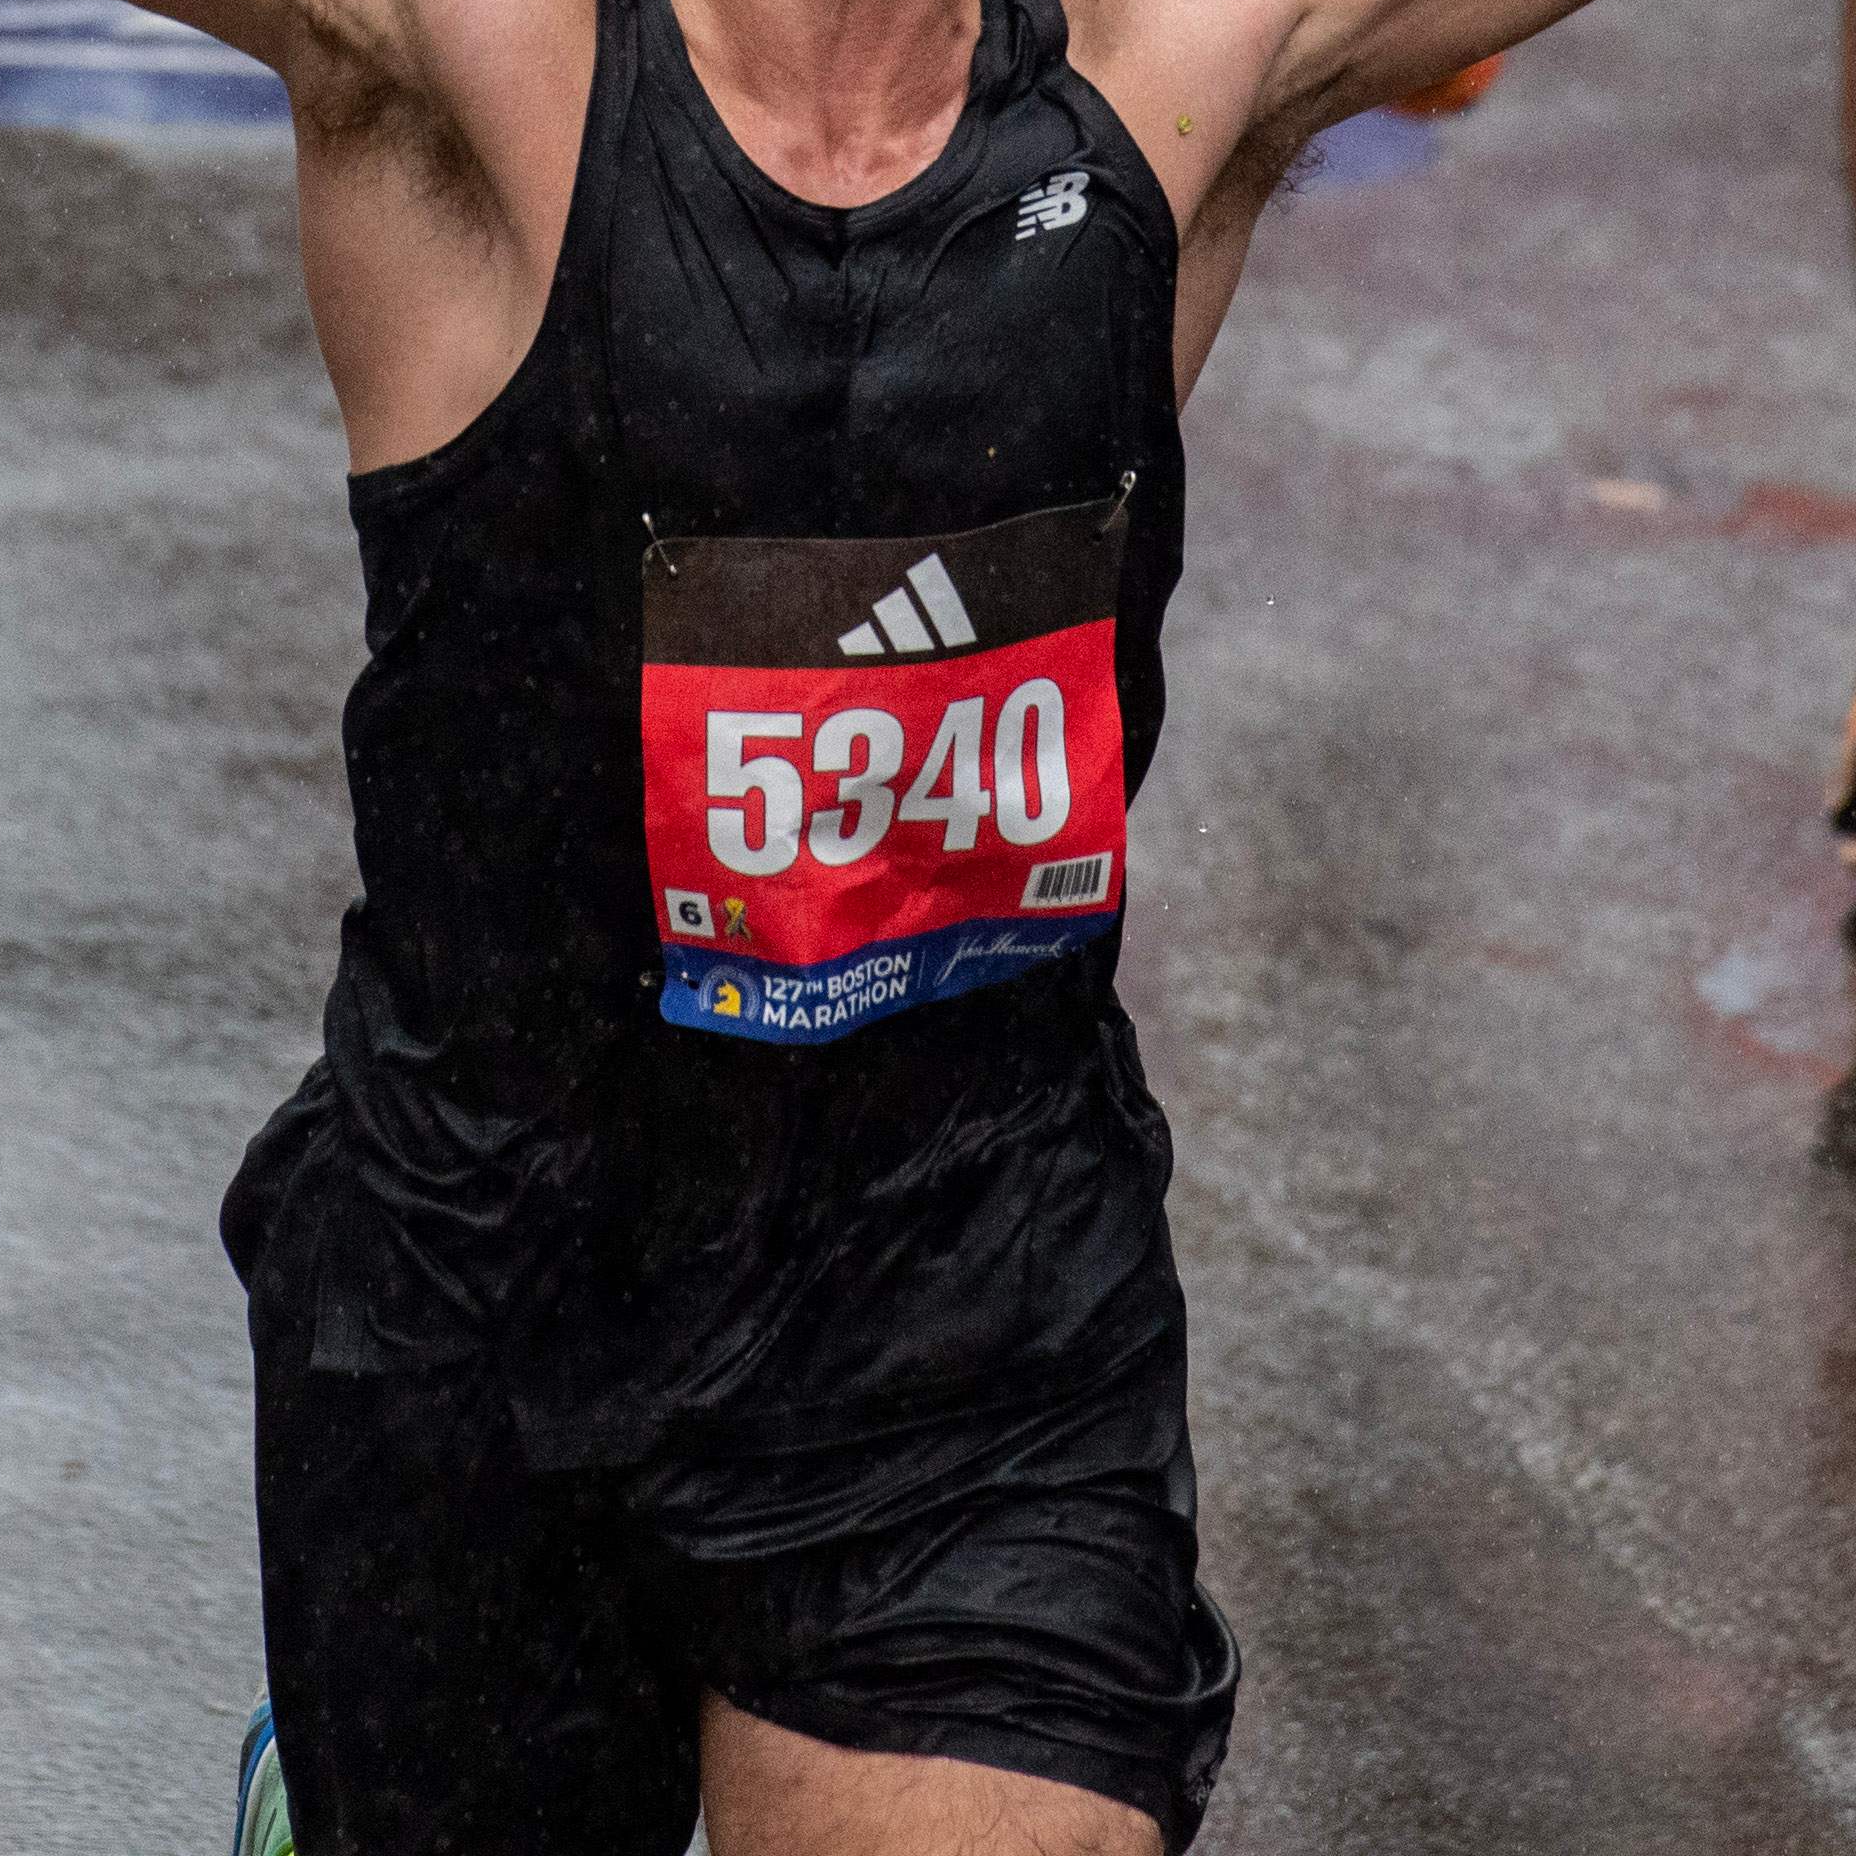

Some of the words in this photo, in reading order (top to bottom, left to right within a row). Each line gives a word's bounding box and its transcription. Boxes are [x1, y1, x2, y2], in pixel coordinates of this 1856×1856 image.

[706, 678, 1071, 877] 5340
[679, 901, 703, 927] 6
[827, 951, 912, 1000] BOSTON
[762, 976, 908, 1029] MARATHON
